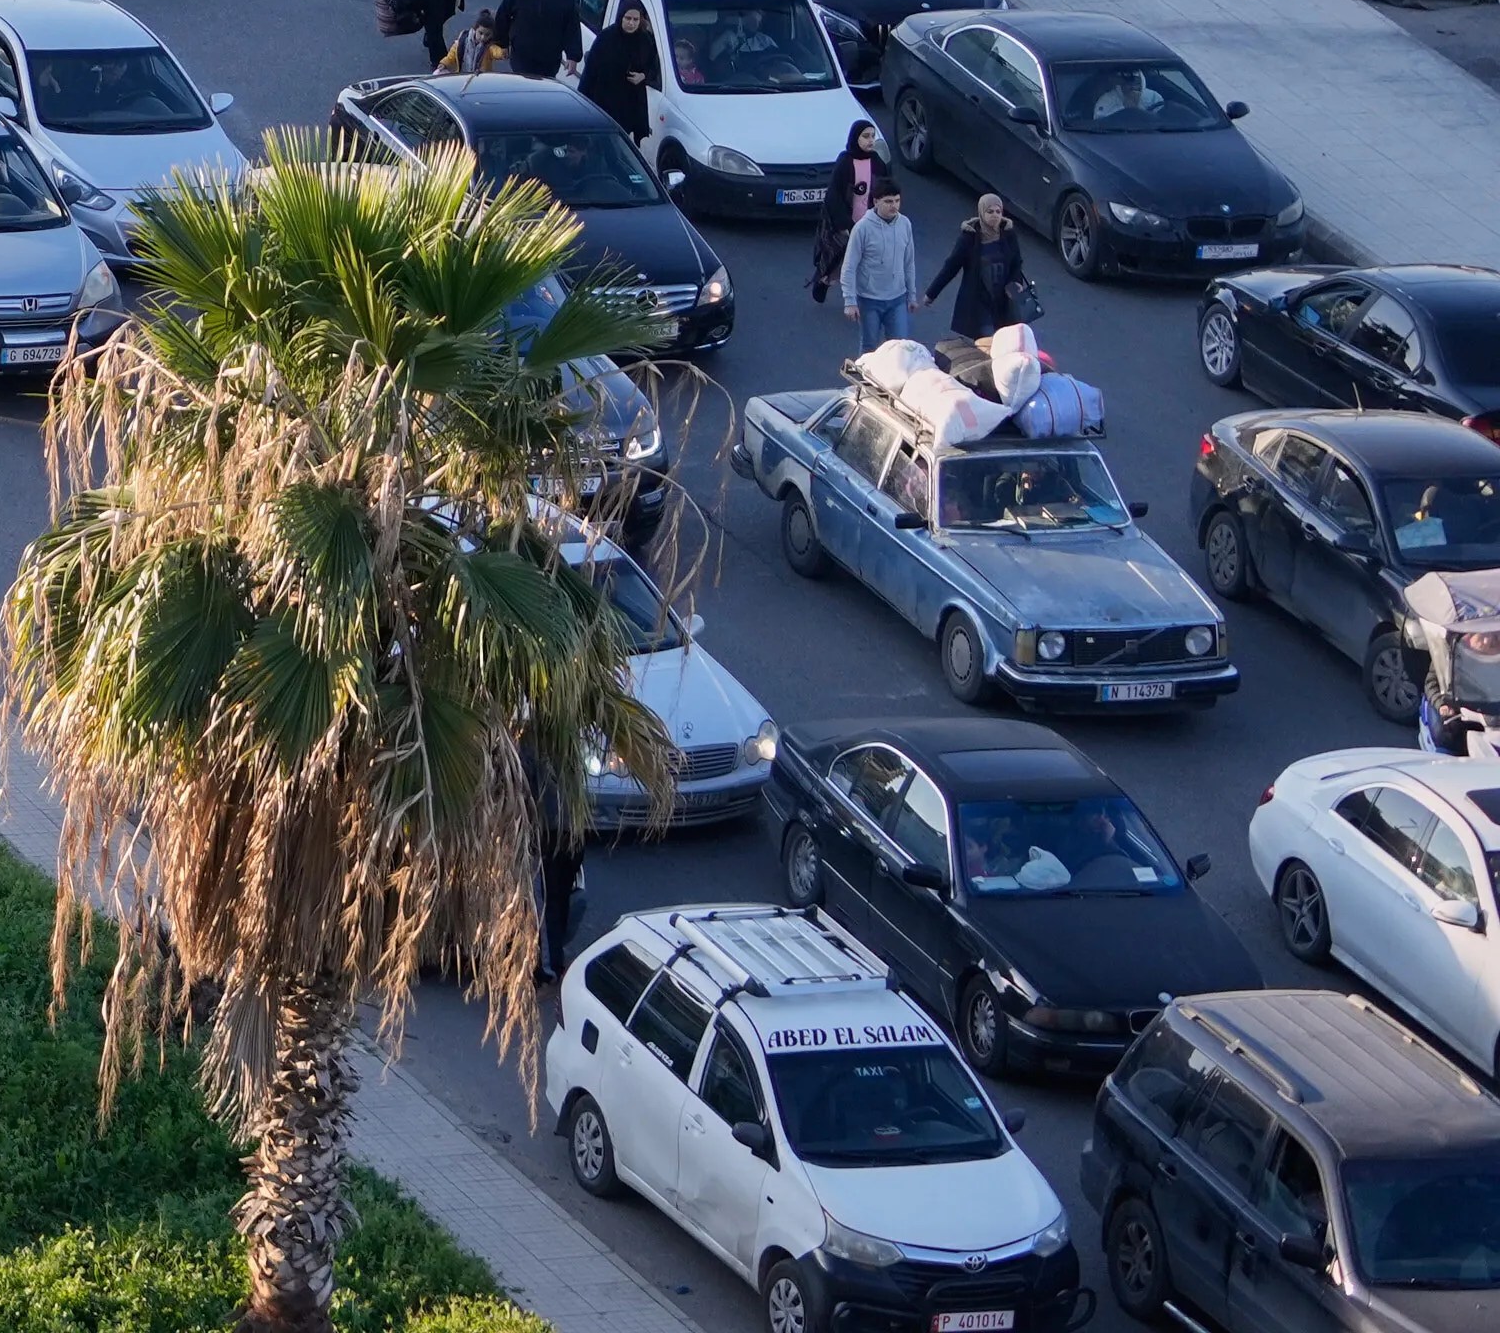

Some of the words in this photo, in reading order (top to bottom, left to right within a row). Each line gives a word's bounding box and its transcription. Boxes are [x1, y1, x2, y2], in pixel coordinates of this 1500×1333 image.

[9, 349, 17, 361] G
[22, 347, 61, 361] 694729
[1110, 686, 1119, 698] N
[1125, 684, 1165, 697] 114379
[767, 1027, 828, 1049] ABED
[836, 1027, 862, 1046] EL
[865, 1025, 936, 1044] SALAM
[854, 1065, 884, 1077] TAXI
[942, 1317, 950, 1329] P
[958, 1311, 1006, 1329] 401014
